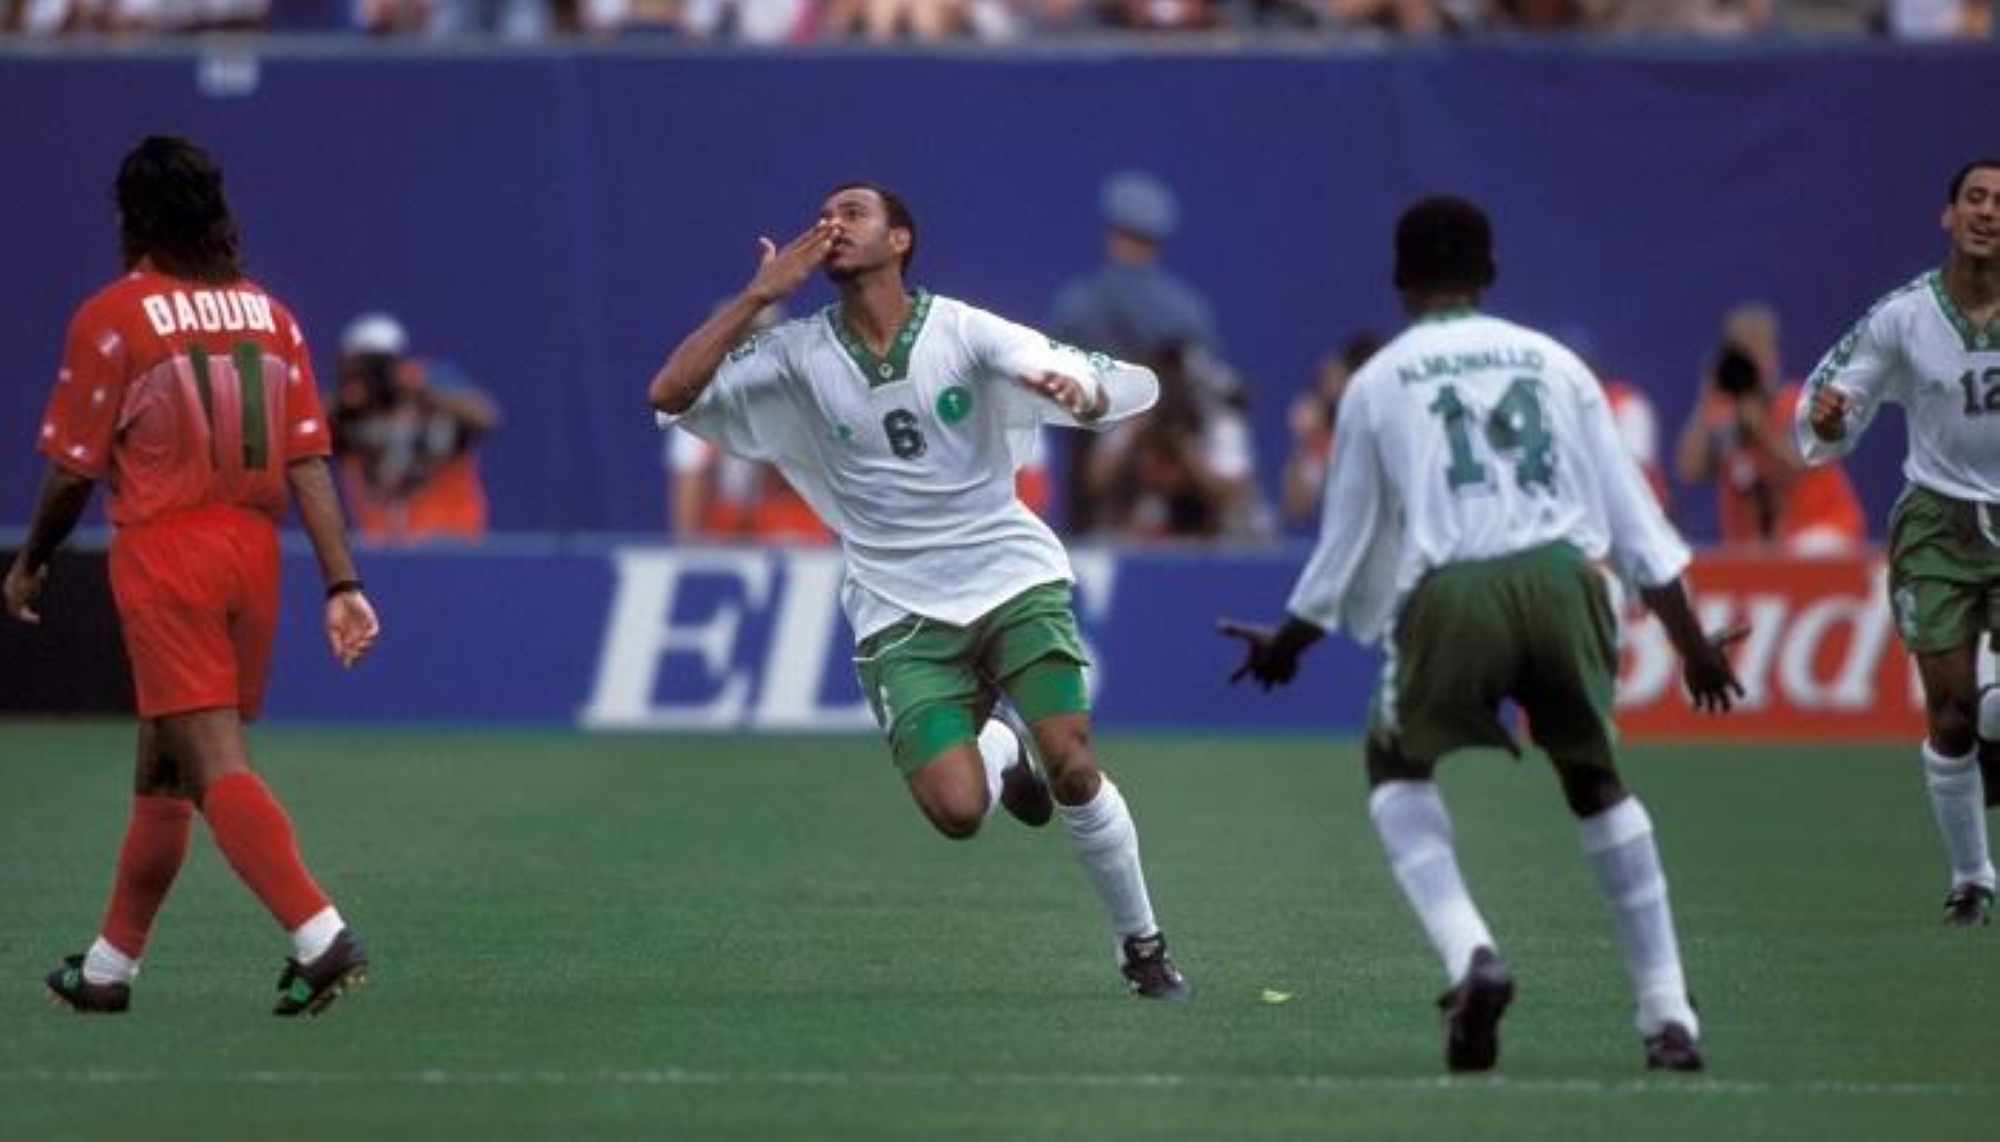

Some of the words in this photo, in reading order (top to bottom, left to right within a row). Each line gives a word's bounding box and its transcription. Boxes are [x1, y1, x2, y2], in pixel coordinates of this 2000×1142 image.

[143, 289, 276, 335] DAOUDI
[187, 341, 269, 470] 11
[1959, 366, 2000, 417] 12
[882, 408, 926, 459] 6
[1428, 376, 1556, 497] 14
